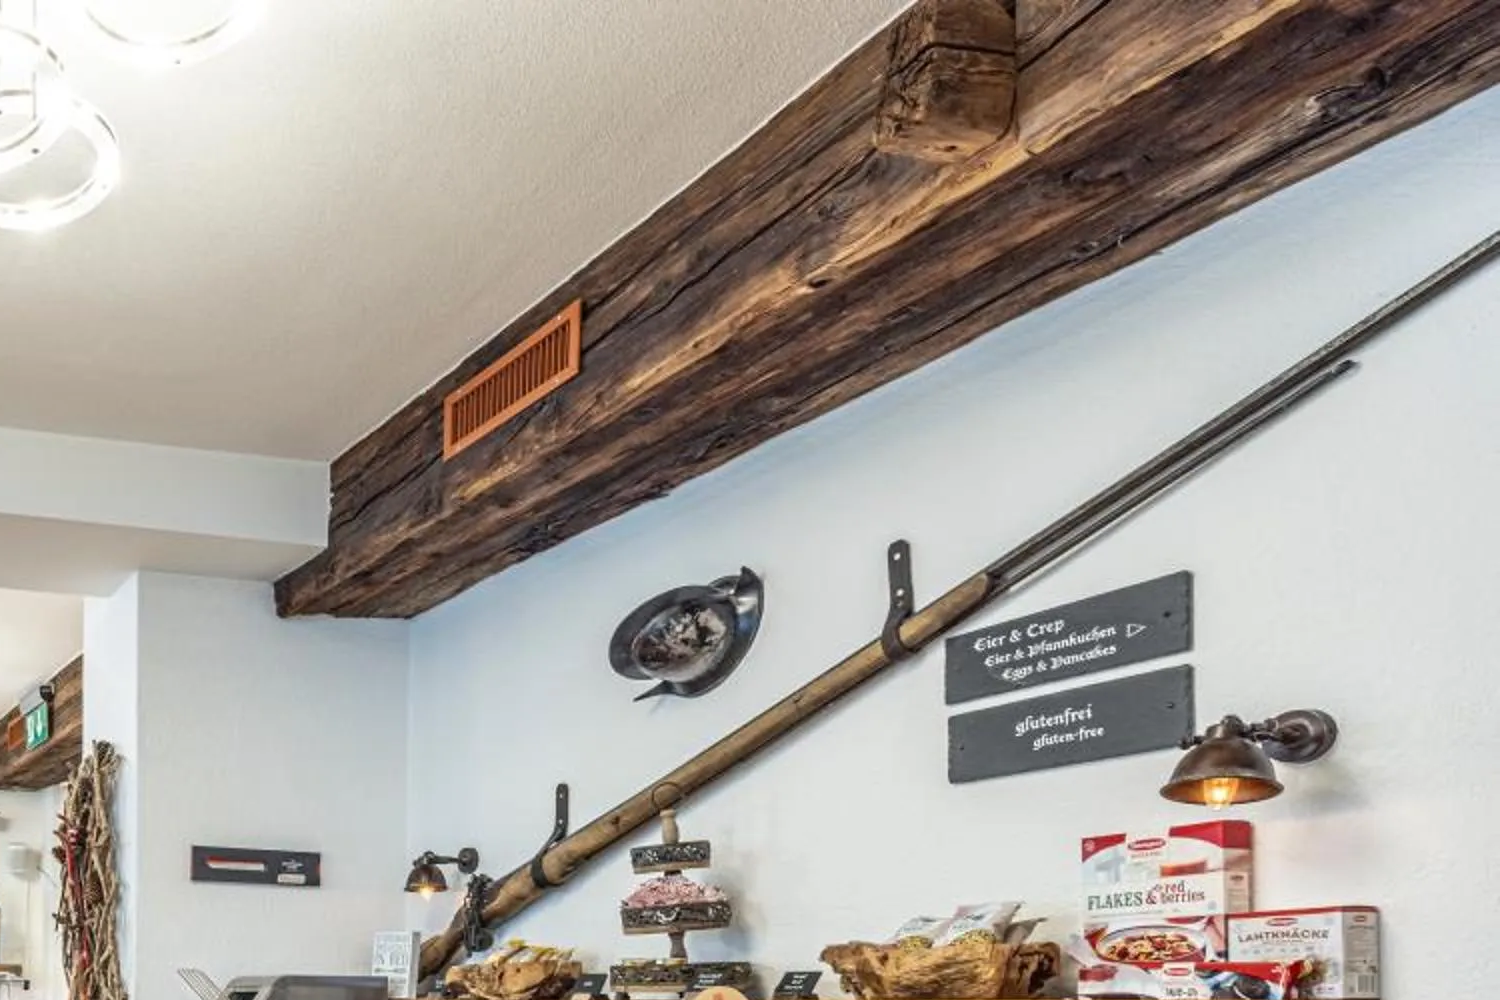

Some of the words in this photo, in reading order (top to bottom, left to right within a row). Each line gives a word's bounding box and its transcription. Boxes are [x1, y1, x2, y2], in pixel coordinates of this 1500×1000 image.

[973, 634, 1007, 651] Eier
[1009, 629, 1023, 643] &
[1026, 619, 1066, 637] Crep
[983, 652, 1012, 667] Eier
[1013, 648, 1025, 661] &
[1027, 625, 1117, 658] Pfannkuchen
[1001, 664, 1034, 681] Eggs
[1036, 659, 1048, 673] &
[1050, 644, 1117, 670] Pancakes
[1015, 703, 1093, 737] glutenfrei
[1032, 725, 1105, 751] gluten-free
[1087, 891, 1143, 911] FLAKES
[1160, 889, 1205, 904] berries
[1165, 880, 1185, 893] red
